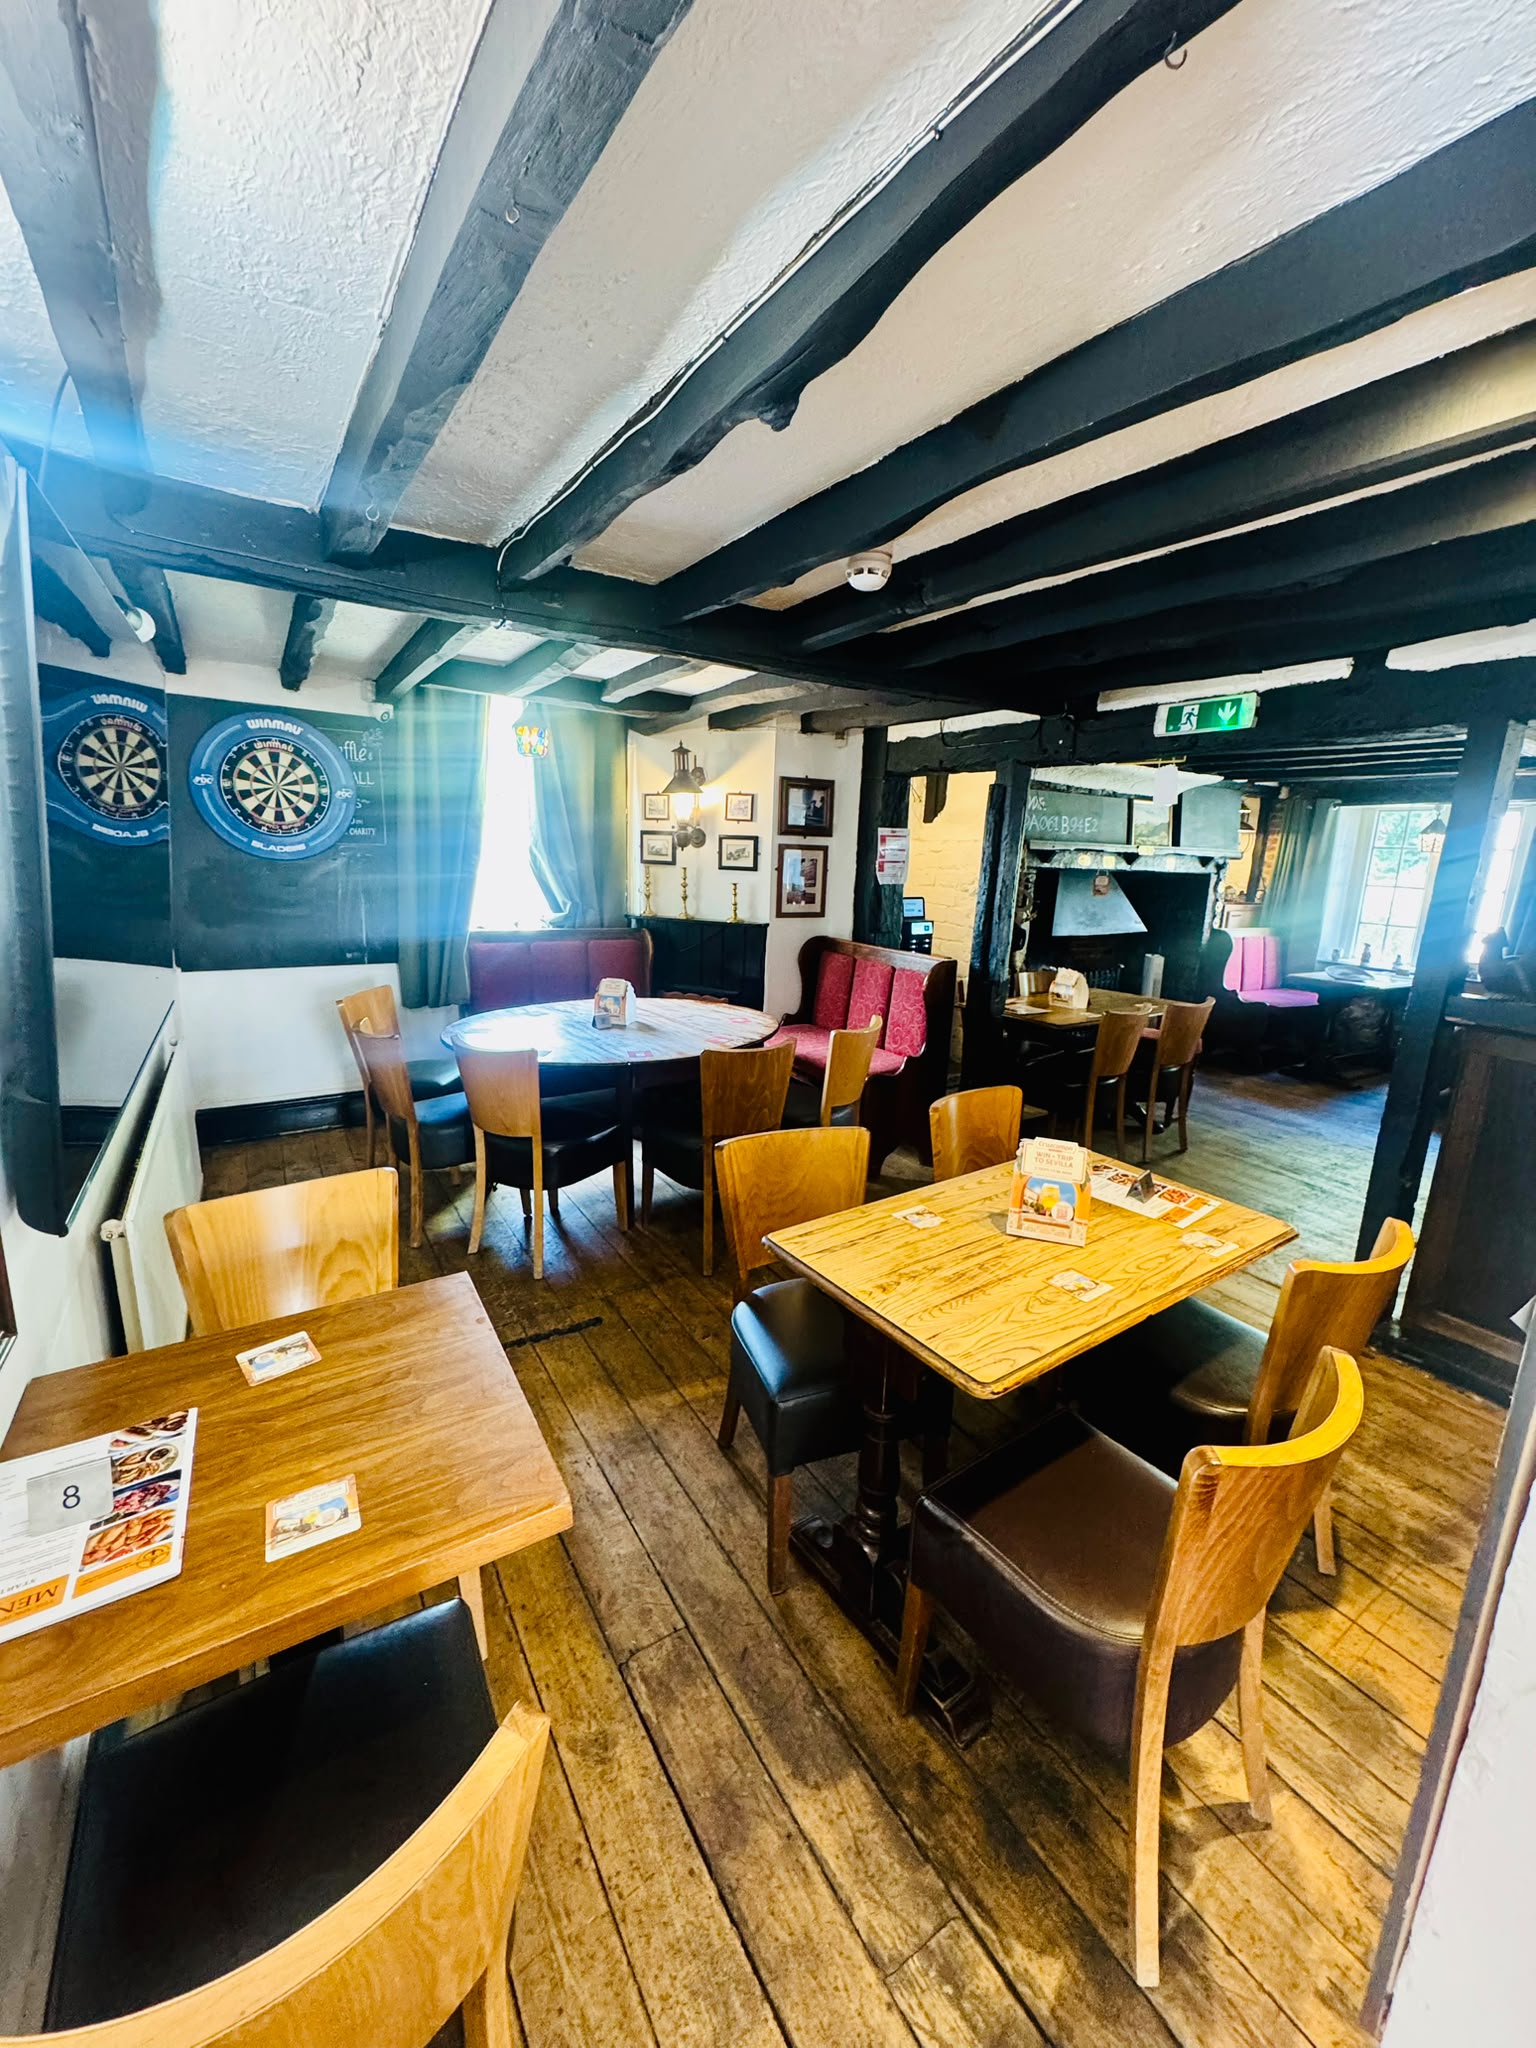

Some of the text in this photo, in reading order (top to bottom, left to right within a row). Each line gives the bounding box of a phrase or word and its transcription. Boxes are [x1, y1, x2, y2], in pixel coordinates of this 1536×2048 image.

[245, 718, 304, 736] WINMAU
[1034, 1156, 1074, 1169] TO SEVILLA
[1036, 1151, 1051, 1159] WIN
[1057, 1154, 1074, 1162] TRIP
[62, 1485, 81, 1509] 8
